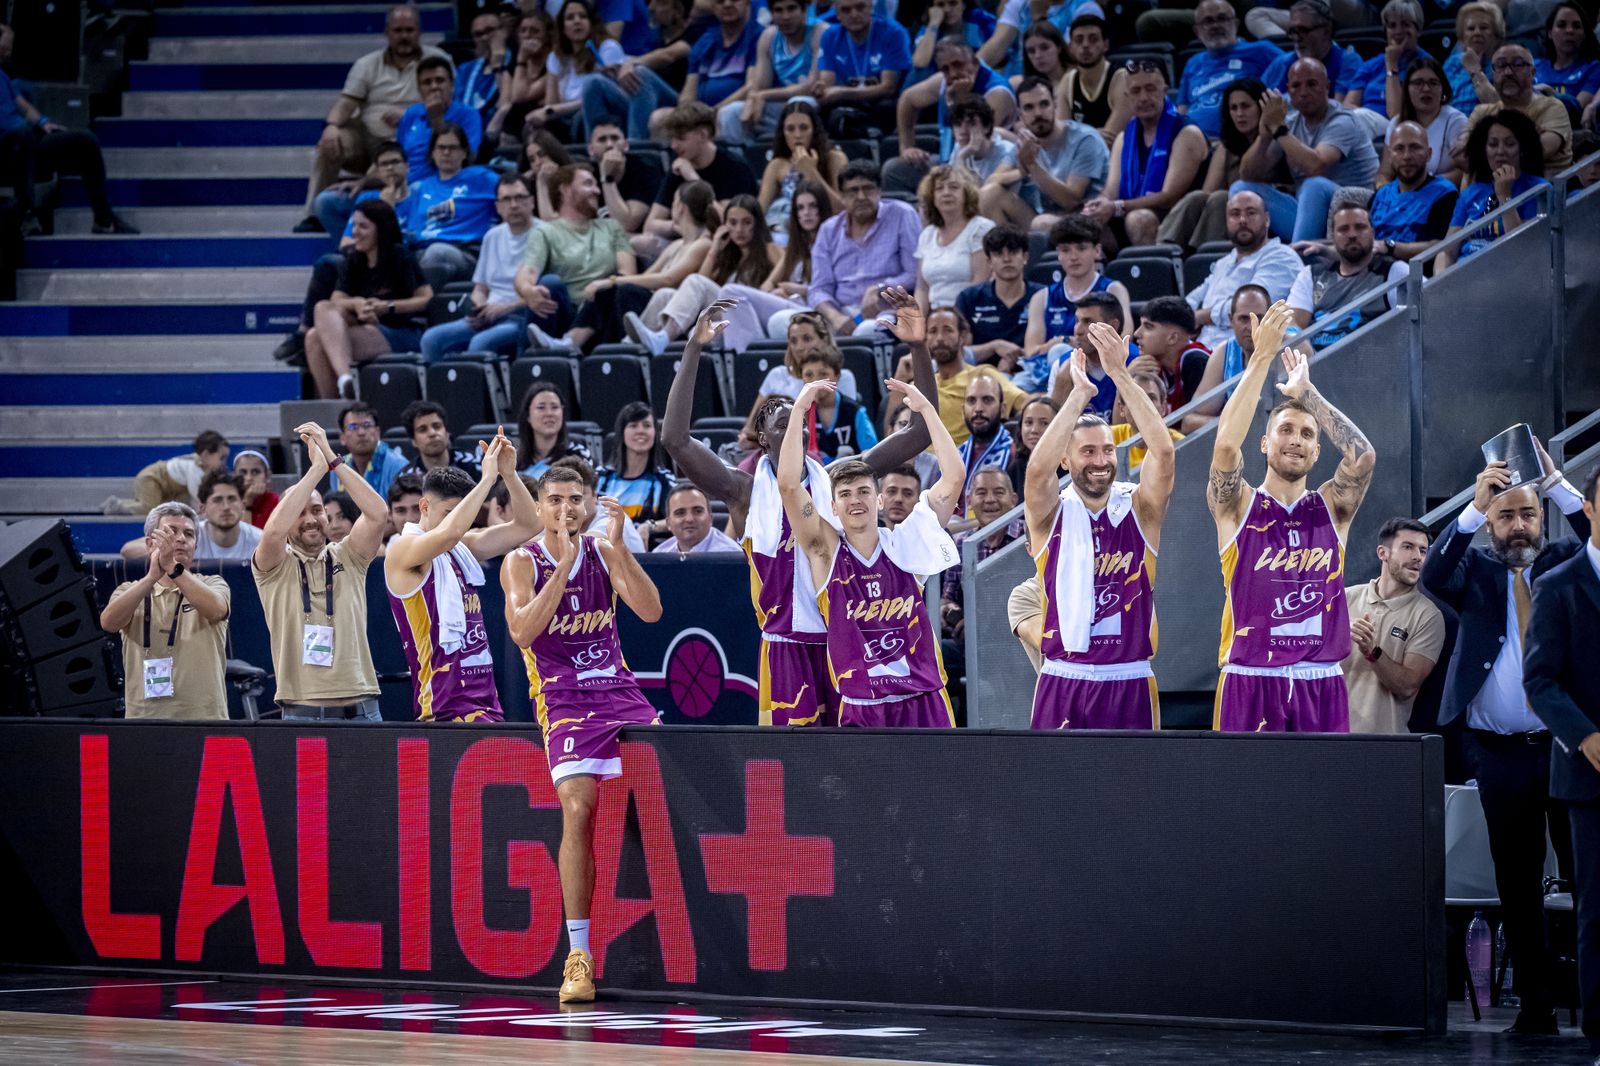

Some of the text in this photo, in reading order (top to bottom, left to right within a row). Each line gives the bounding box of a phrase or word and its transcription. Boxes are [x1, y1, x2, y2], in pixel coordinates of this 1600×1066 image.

[834, 425, 851, 445] 17
[1254, 547, 1333, 573] LLEIDA
[866, 581, 881, 598] 13
[1275, 584, 1317, 615] ICG
[571, 595, 580, 611] 0
[549, 607, 613, 635] LLEIDA
[1270, 637, 1323, 646] Software
[563, 737, 575, 752] 0
[80, 734, 834, 983] LALIGA+
[170, 997, 927, 1037] LALIGA+
